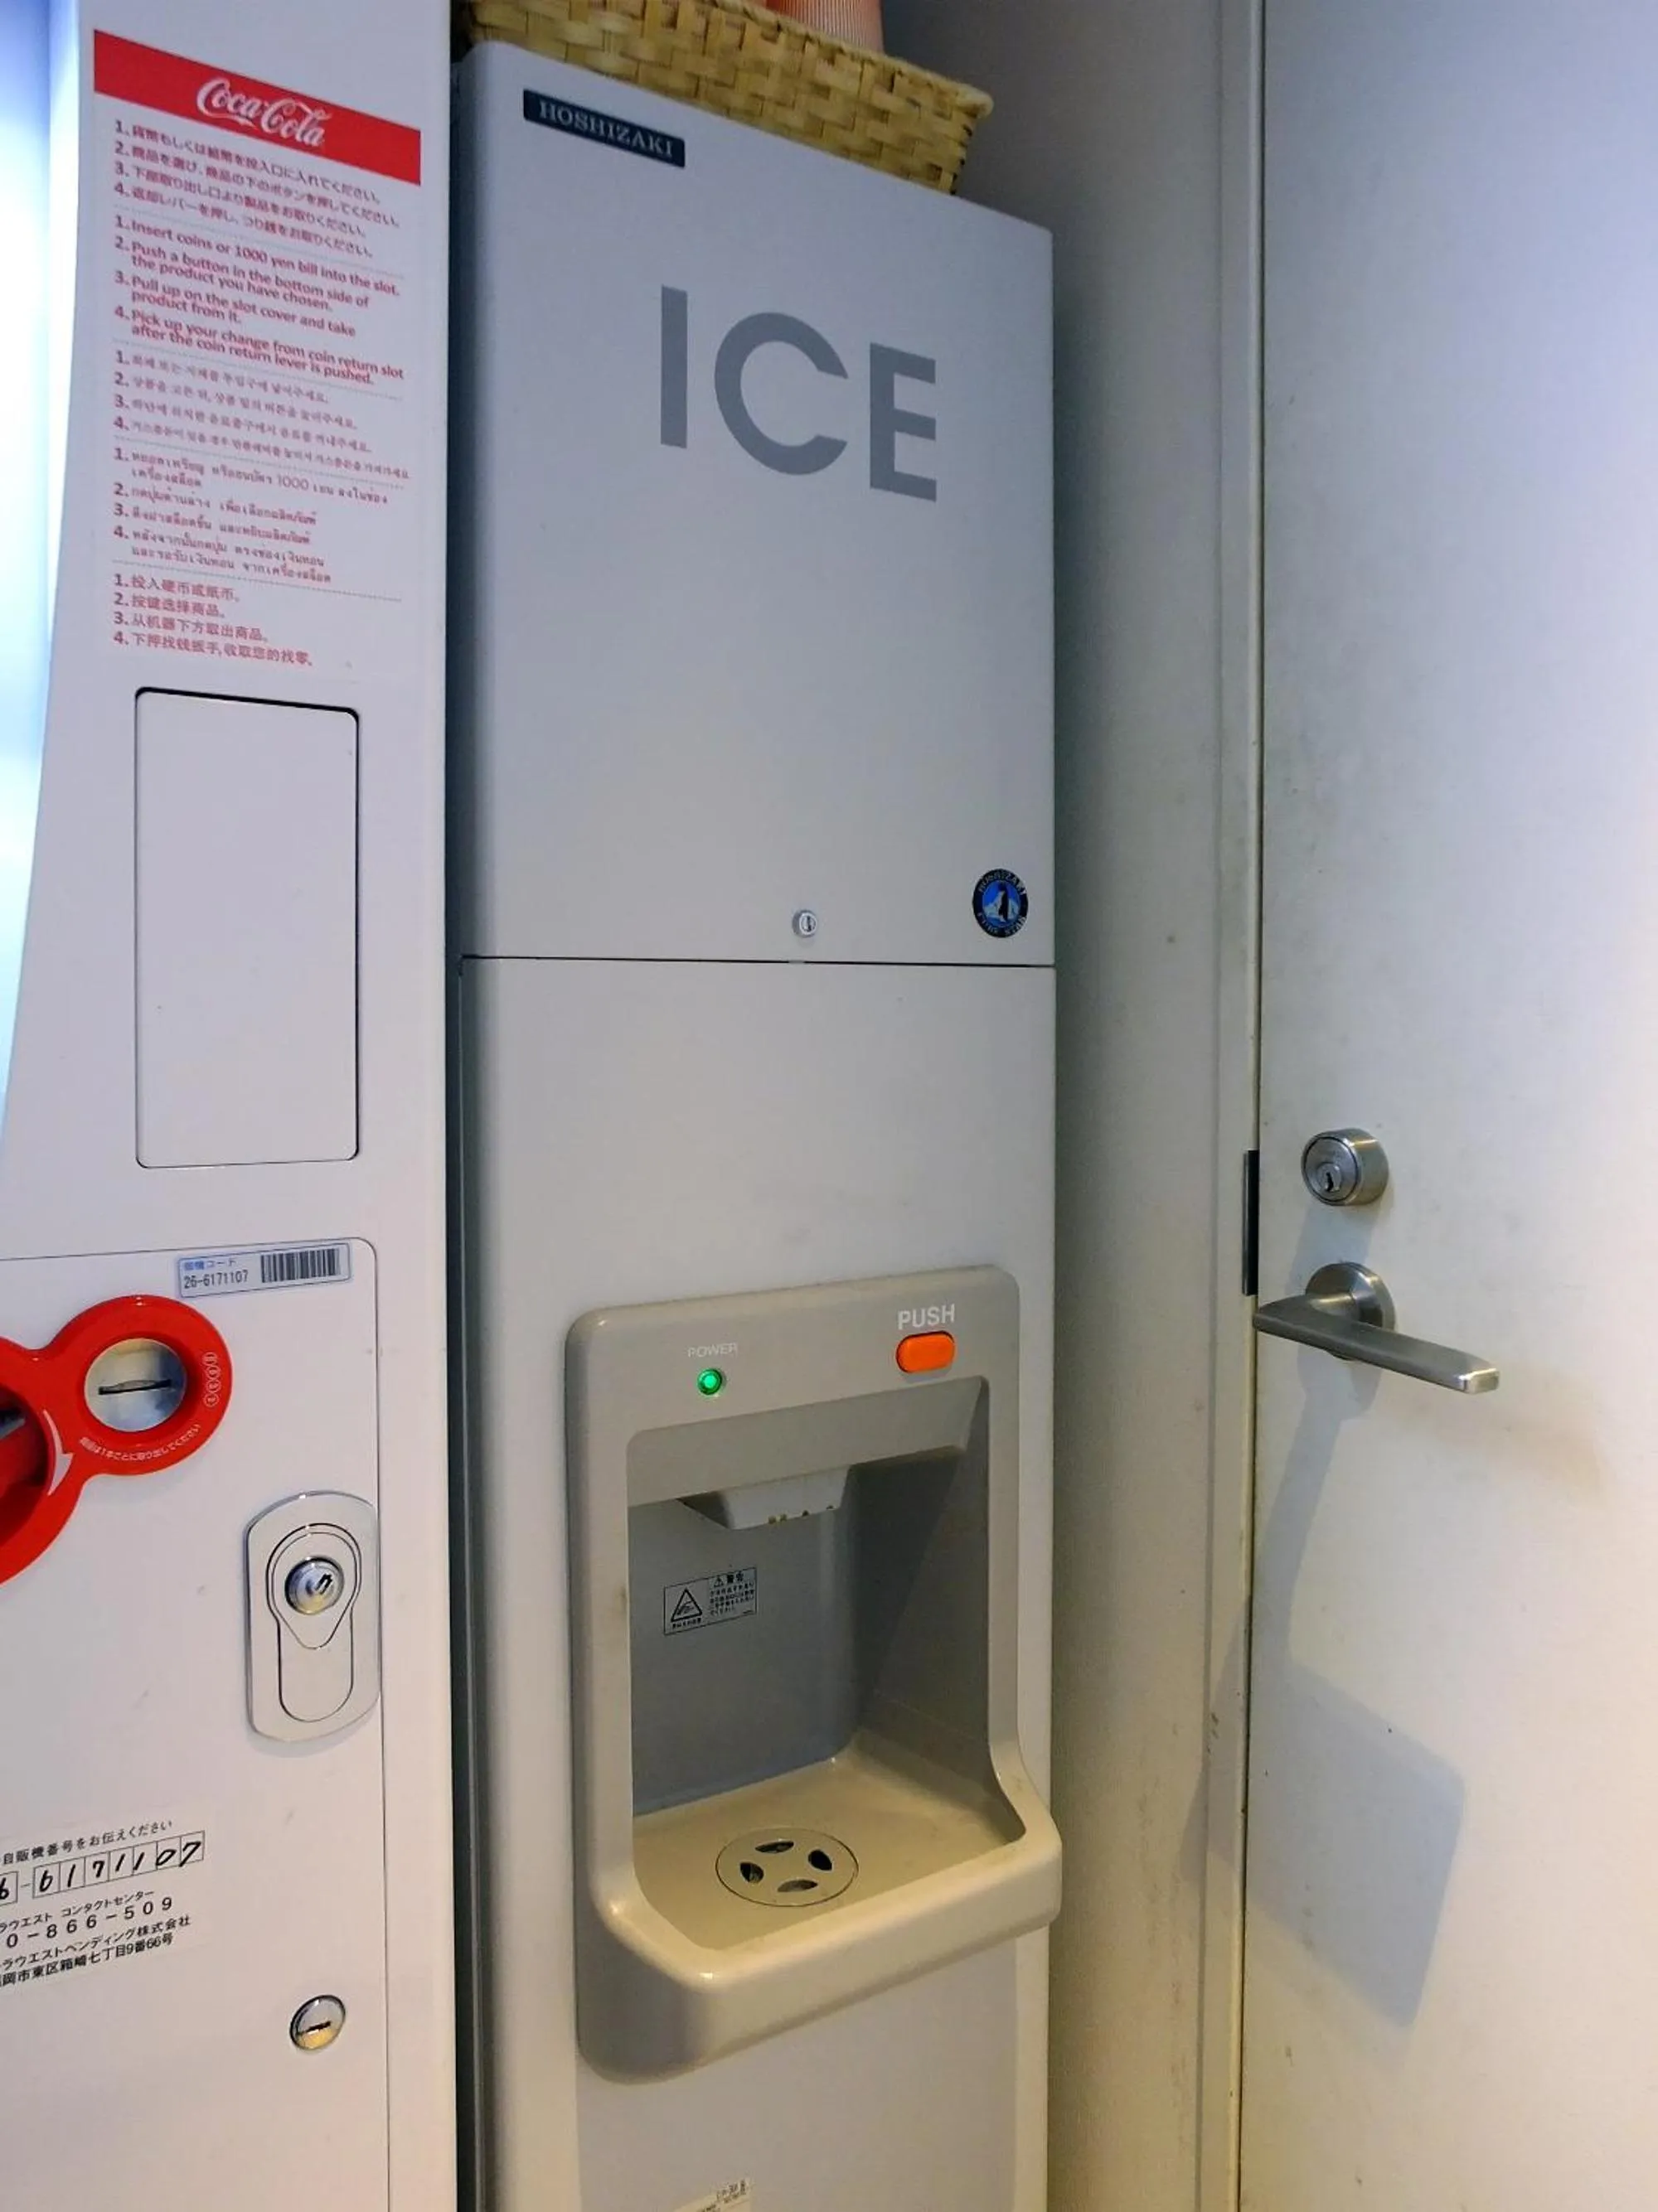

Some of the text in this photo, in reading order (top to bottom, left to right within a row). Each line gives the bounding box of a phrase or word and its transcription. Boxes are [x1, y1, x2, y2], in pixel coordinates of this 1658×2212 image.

[196, 78, 332, 148] Coca-Cola
[540, 100, 673, 157] HOSHIZAKI
[132, 220, 172, 241] Insert
[177, 231, 212, 249] coins
[216, 242, 230, 254] or
[235, 247, 267, 264] 1000
[271, 256, 294, 271] yen
[298, 261, 318, 277] bill
[321, 268, 347, 283] into
[351, 274, 370, 288] the
[132, 242, 166, 259] Push
[171, 253, 178, 263] a
[182, 253, 229, 274] button
[232, 266, 245, 278] in
[249, 269, 271, 285] the
[275, 275, 323, 297] bottom
[327, 287, 352, 304] side
[356, 295, 370, 307] of
[132, 254, 155, 269] the
[159, 262, 214, 285] product
[218, 278, 244, 292] you
[247, 283, 279, 300] have
[132, 276, 158, 292] Pull
[163, 287, 181, 300] up
[184, 289, 202, 301] on
[207, 292, 229, 307] the
[232, 298, 256, 315] slot
[260, 306, 297, 322] cover
[300, 313, 323, 330] and
[328, 320, 356, 336] take
[132, 292, 187, 313] product
[191, 302, 225, 321] from
[132, 310, 160, 327] Pick
[164, 319, 182, 333] up
[187, 323, 217, 339] your
[221, 331, 269, 352] change
[274, 341, 305, 357] from
[308, 349, 335, 364] coin
[338, 355, 378, 373] return
[381, 365, 403, 380] slot
[132, 325, 166, 341] after
[170, 331, 192, 346] the
[197, 336, 225, 354] coin
[230, 343, 271, 364] return
[275, 353, 308, 370] lever
[311, 362, 320, 374] is
[661, 284, 937, 502] ICE
[278, 474, 308, 491] 1000
[183, 1270, 249, 1290] 26-6171107
[897, 1304, 956, 1330] PUSH
[687, 1343, 738, 1359] POWER
[61, 1890, 155, 1918] コンタクトセンター
[0, 1914, 191, 1972] ラウエストベンディング株式会社
[0, 1932, 174, 1987] 岡市東区箱崎七丁目9番66号
